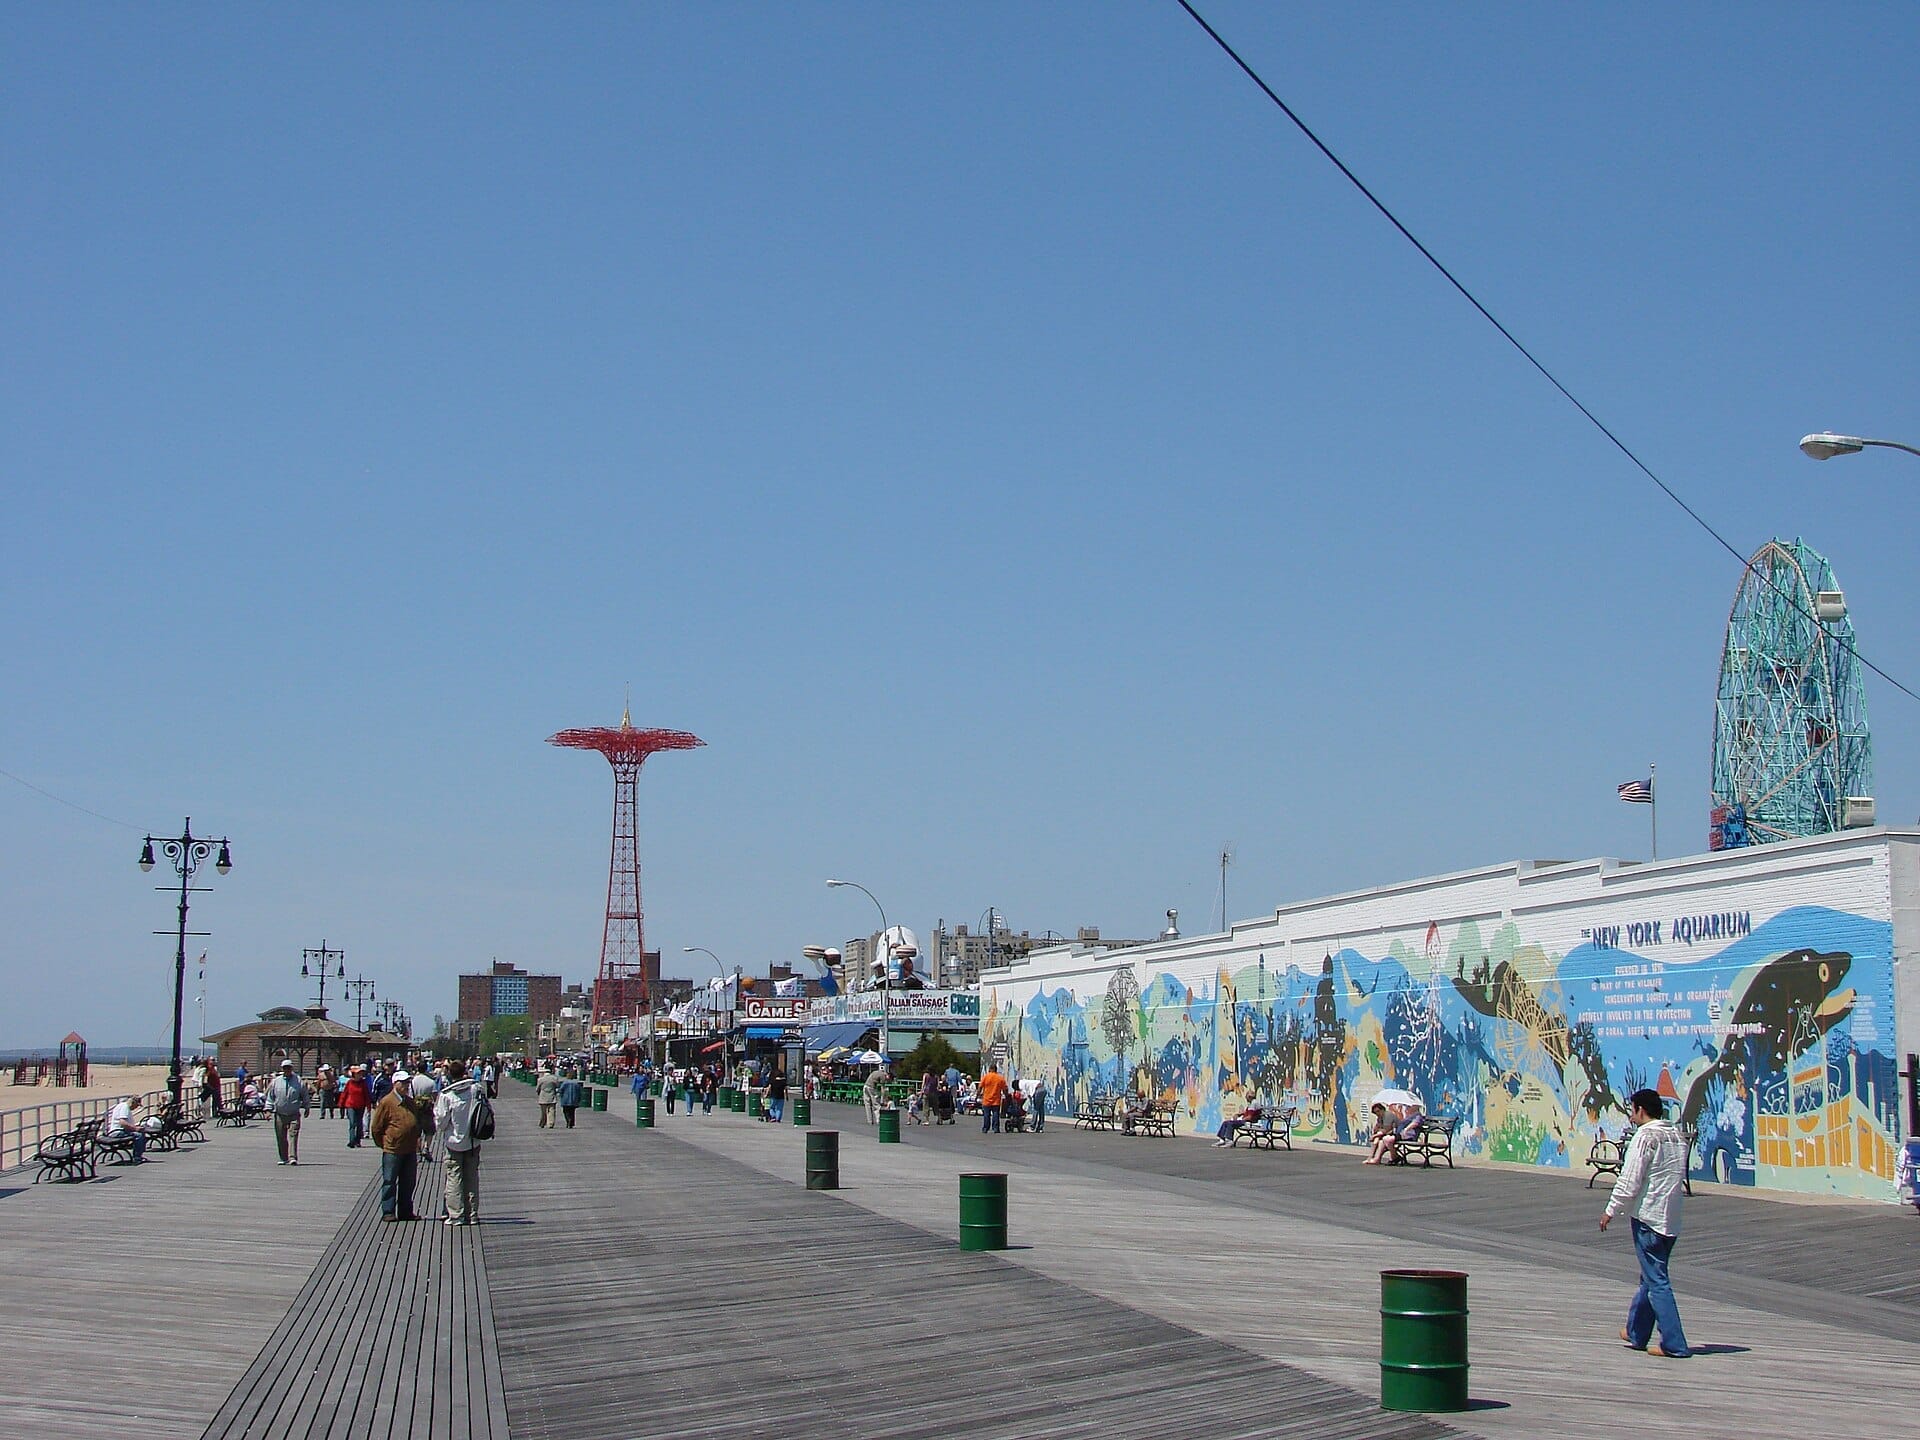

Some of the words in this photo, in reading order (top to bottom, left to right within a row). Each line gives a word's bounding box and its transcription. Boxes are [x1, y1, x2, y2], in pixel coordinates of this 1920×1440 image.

[1581, 928, 1591, 939] THE
[1592, 925, 1621, 951] NEW
[1626, 920, 1662, 948] YORK
[1672, 910, 1751, 947] AQUARIUM
[1624, 979, 1635, 989] THE
[888, 997, 911, 1008] TALIAN
[911, 996, 948, 1008] SAUSAGE
[1673, 991, 1683, 1002] AN
[748, 1001, 804, 1018] GAMES
[1606, 1010, 1632, 1022] INVOLVED
[1643, 1009, 1653, 1020] THE
[1655, 1008, 1692, 1021] PROTECTION
[1606, 1026, 1624, 1036] CORAL
[1675, 1024, 1689, 1035] AND
